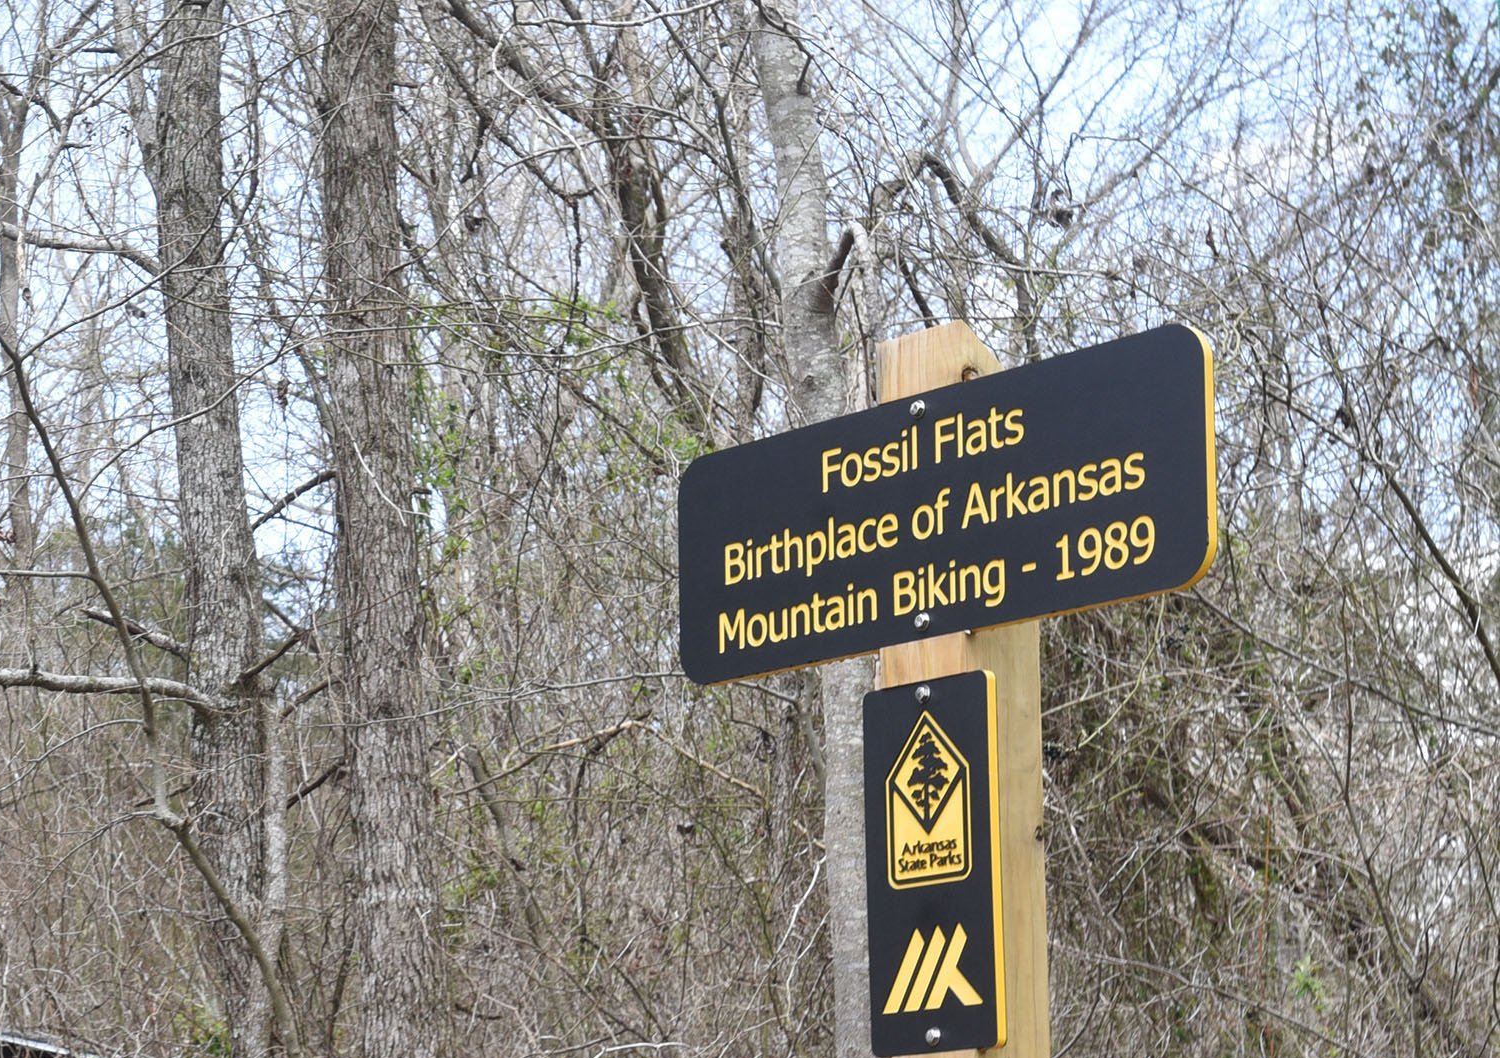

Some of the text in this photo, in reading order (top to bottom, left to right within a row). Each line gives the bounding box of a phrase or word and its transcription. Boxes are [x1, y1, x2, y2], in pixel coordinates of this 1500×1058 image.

[821, 406, 1025, 493] Fossil Flats
[724, 451, 1146, 586] Birthplace of Arkansas
[718, 515, 1156, 654] Mountain Biking - 1989
[898, 850, 962, 873] State Parks
[901, 838, 958, 857] Arkansas
